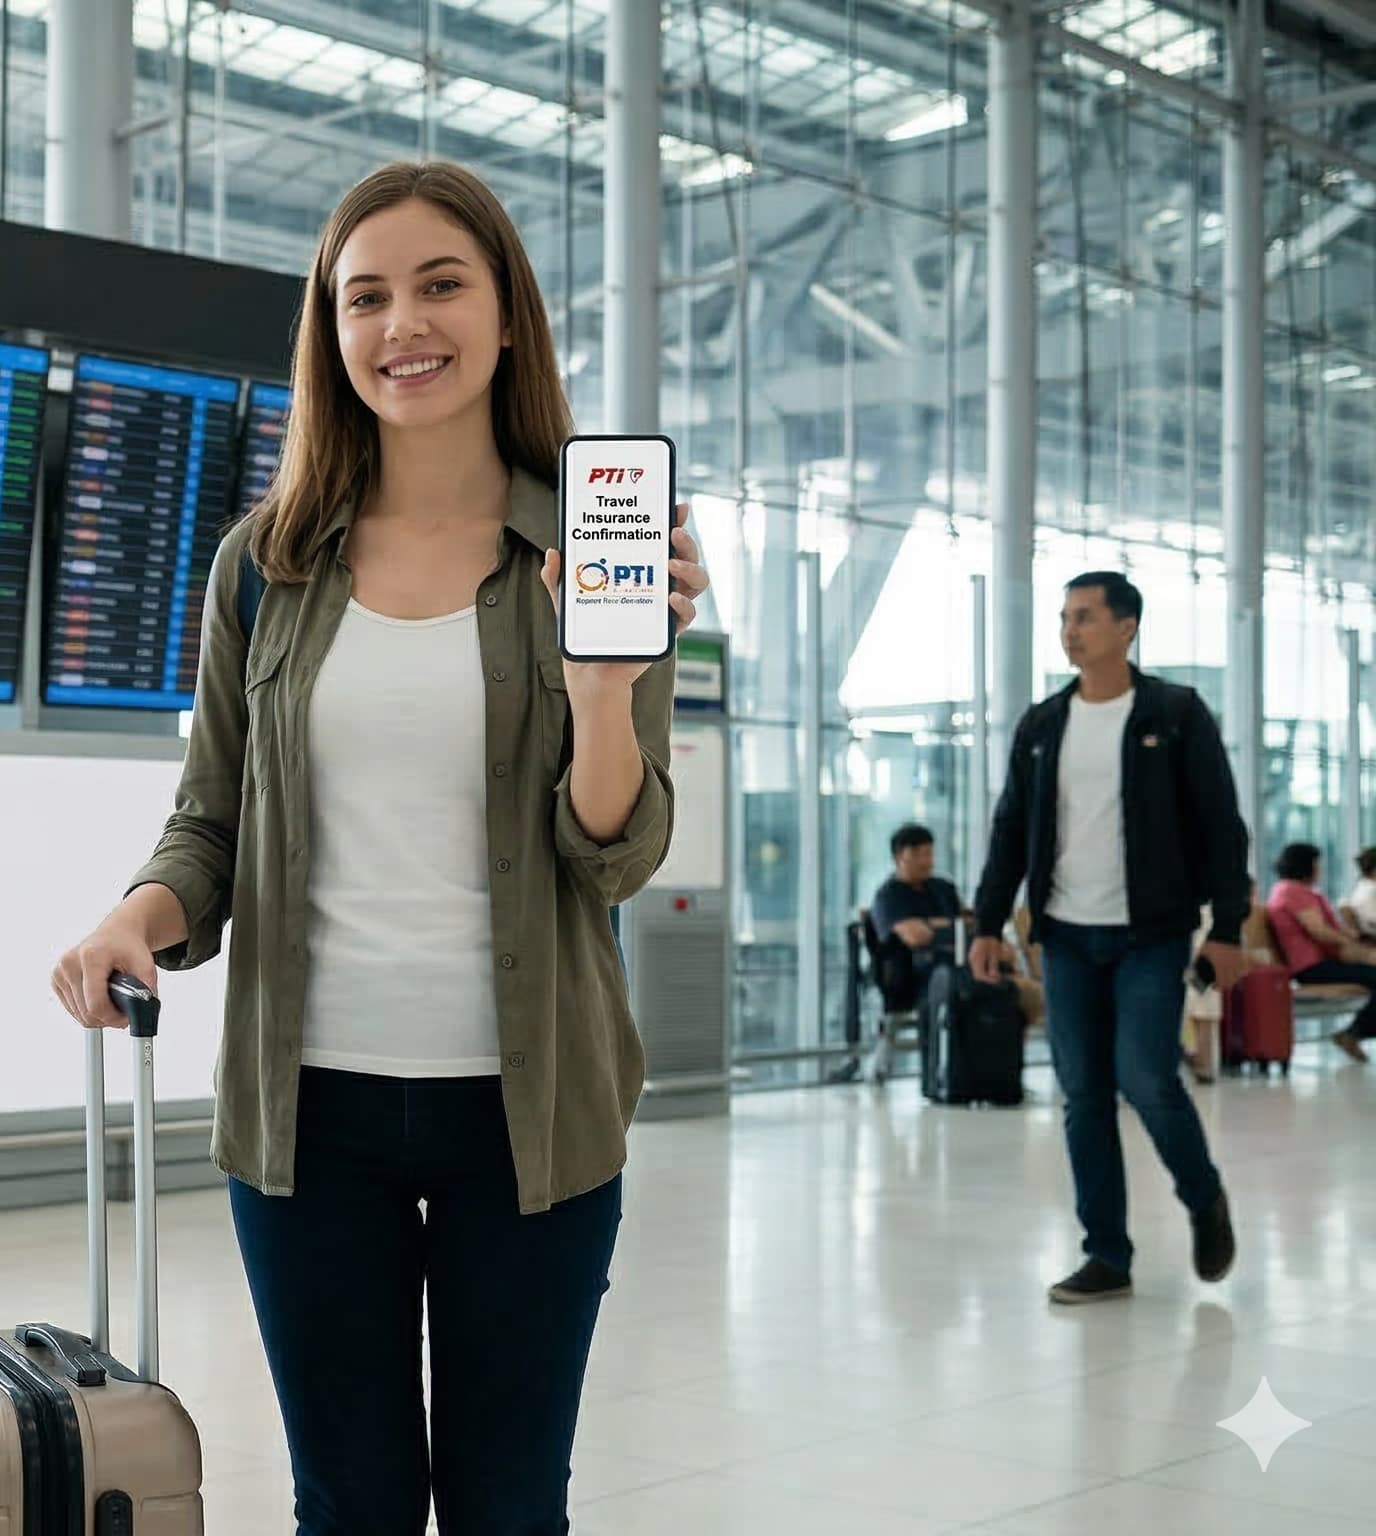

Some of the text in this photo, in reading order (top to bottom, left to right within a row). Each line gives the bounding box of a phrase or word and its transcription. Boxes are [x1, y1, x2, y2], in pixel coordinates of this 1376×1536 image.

[595, 495, 638, 507] Travel
[582, 512, 651, 524] Insurance
[572, 528, 662, 541] Confirmation
[614, 565, 654, 586] PTI
